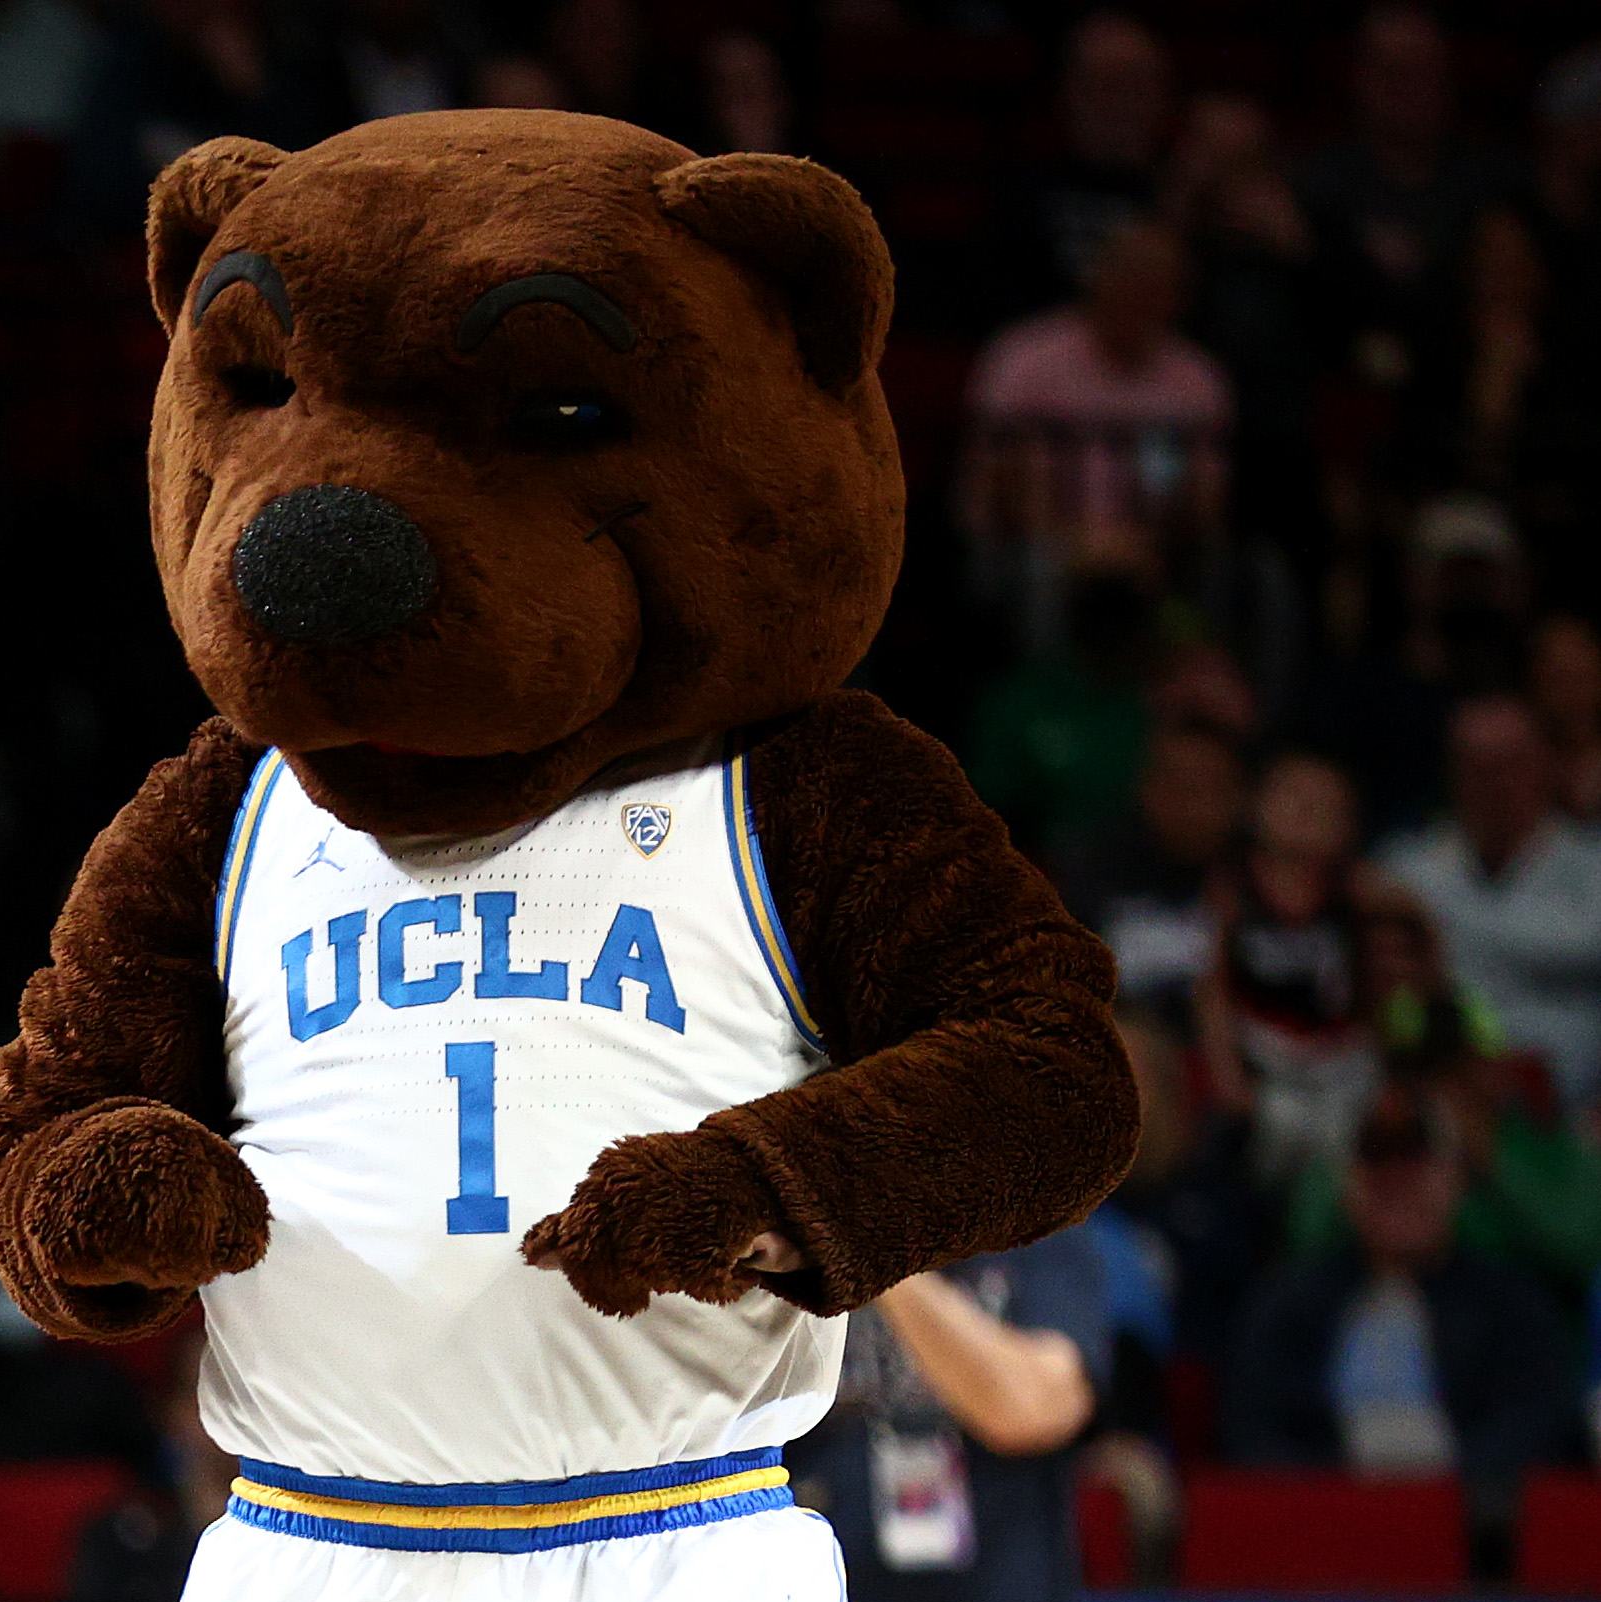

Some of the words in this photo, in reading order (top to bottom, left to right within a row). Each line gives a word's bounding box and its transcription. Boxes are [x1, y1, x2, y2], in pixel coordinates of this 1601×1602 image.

[626, 806, 670, 836] PAC
[636, 825, 659, 846] 12
[280, 891, 686, 1042] UCLA
[445, 1041, 510, 1235] 1
